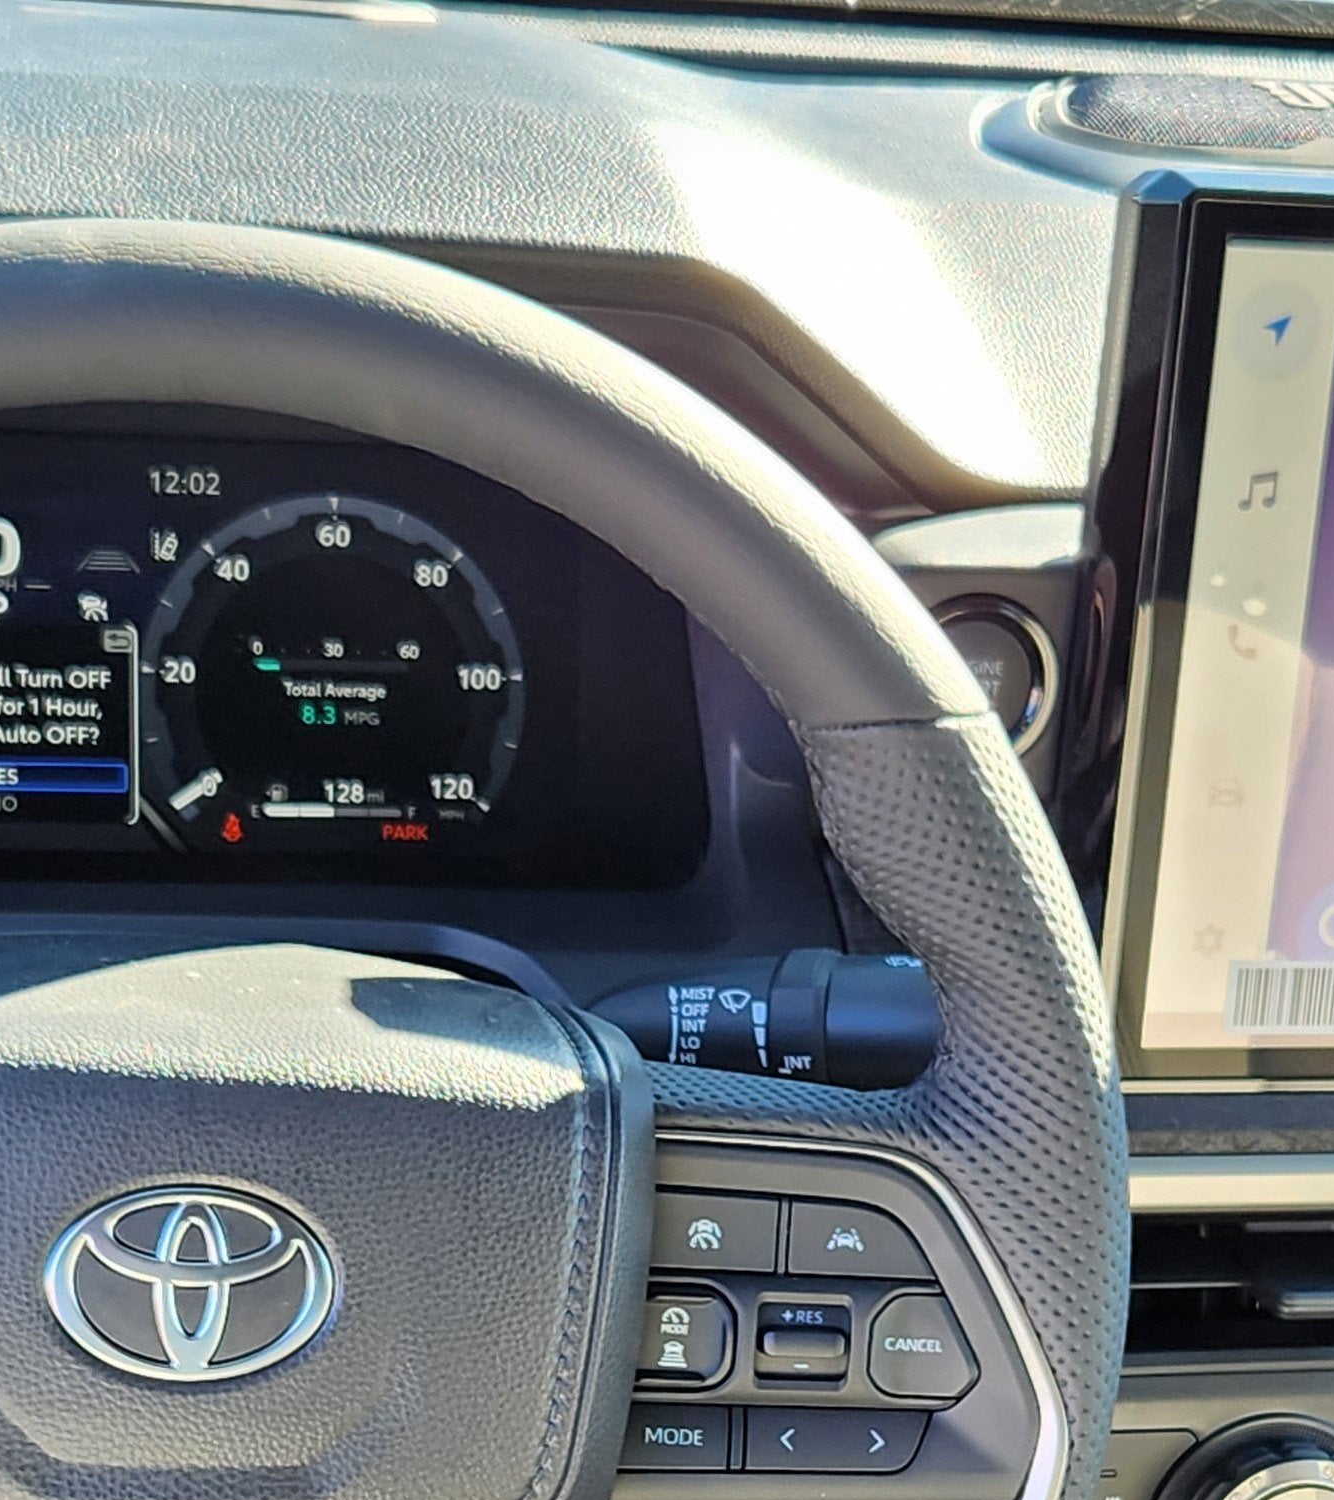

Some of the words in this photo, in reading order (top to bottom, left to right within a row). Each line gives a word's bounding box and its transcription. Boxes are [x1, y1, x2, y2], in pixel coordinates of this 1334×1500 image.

[150, 470, 221, 496] 12:02
[317, 522, 351, 548] 60
[215, 559, 250, 582] 40
[414, 562, 448, 587] 80
[323, 642, 344, 658] 30
[399, 641, 420, 660] 60
[15, 665, 64, 689] Turn
[67, 666, 112, 690] OFF
[164, 659, 196, 684] 20
[459, 668, 502, 690] 100
[283, 681, 321, 699] Total
[324, 683, 387, 702] Average
[29, 698, 39, 716] 1
[44, 698, 103, 720] Hour,
[302, 706, 336, 725] 8.3
[344, 711, 380, 727] MPG
[45, 724, 100, 745] OFF?
[324, 781, 365, 804] 128
[430, 775, 474, 800] 120
[382, 824, 428, 841] PARK
[680, 987, 715, 1001] MIST
[681, 1003, 709, 1017] OFF
[681, 1019, 706, 1034] INT
[680, 1037, 700, 1049] LO
[680, 1053, 696, 1064] HI
[784, 1056, 811, 1071] INT
[885, 1336, 943, 1354] CANCEL
[644, 1426, 704, 1447] MODE
